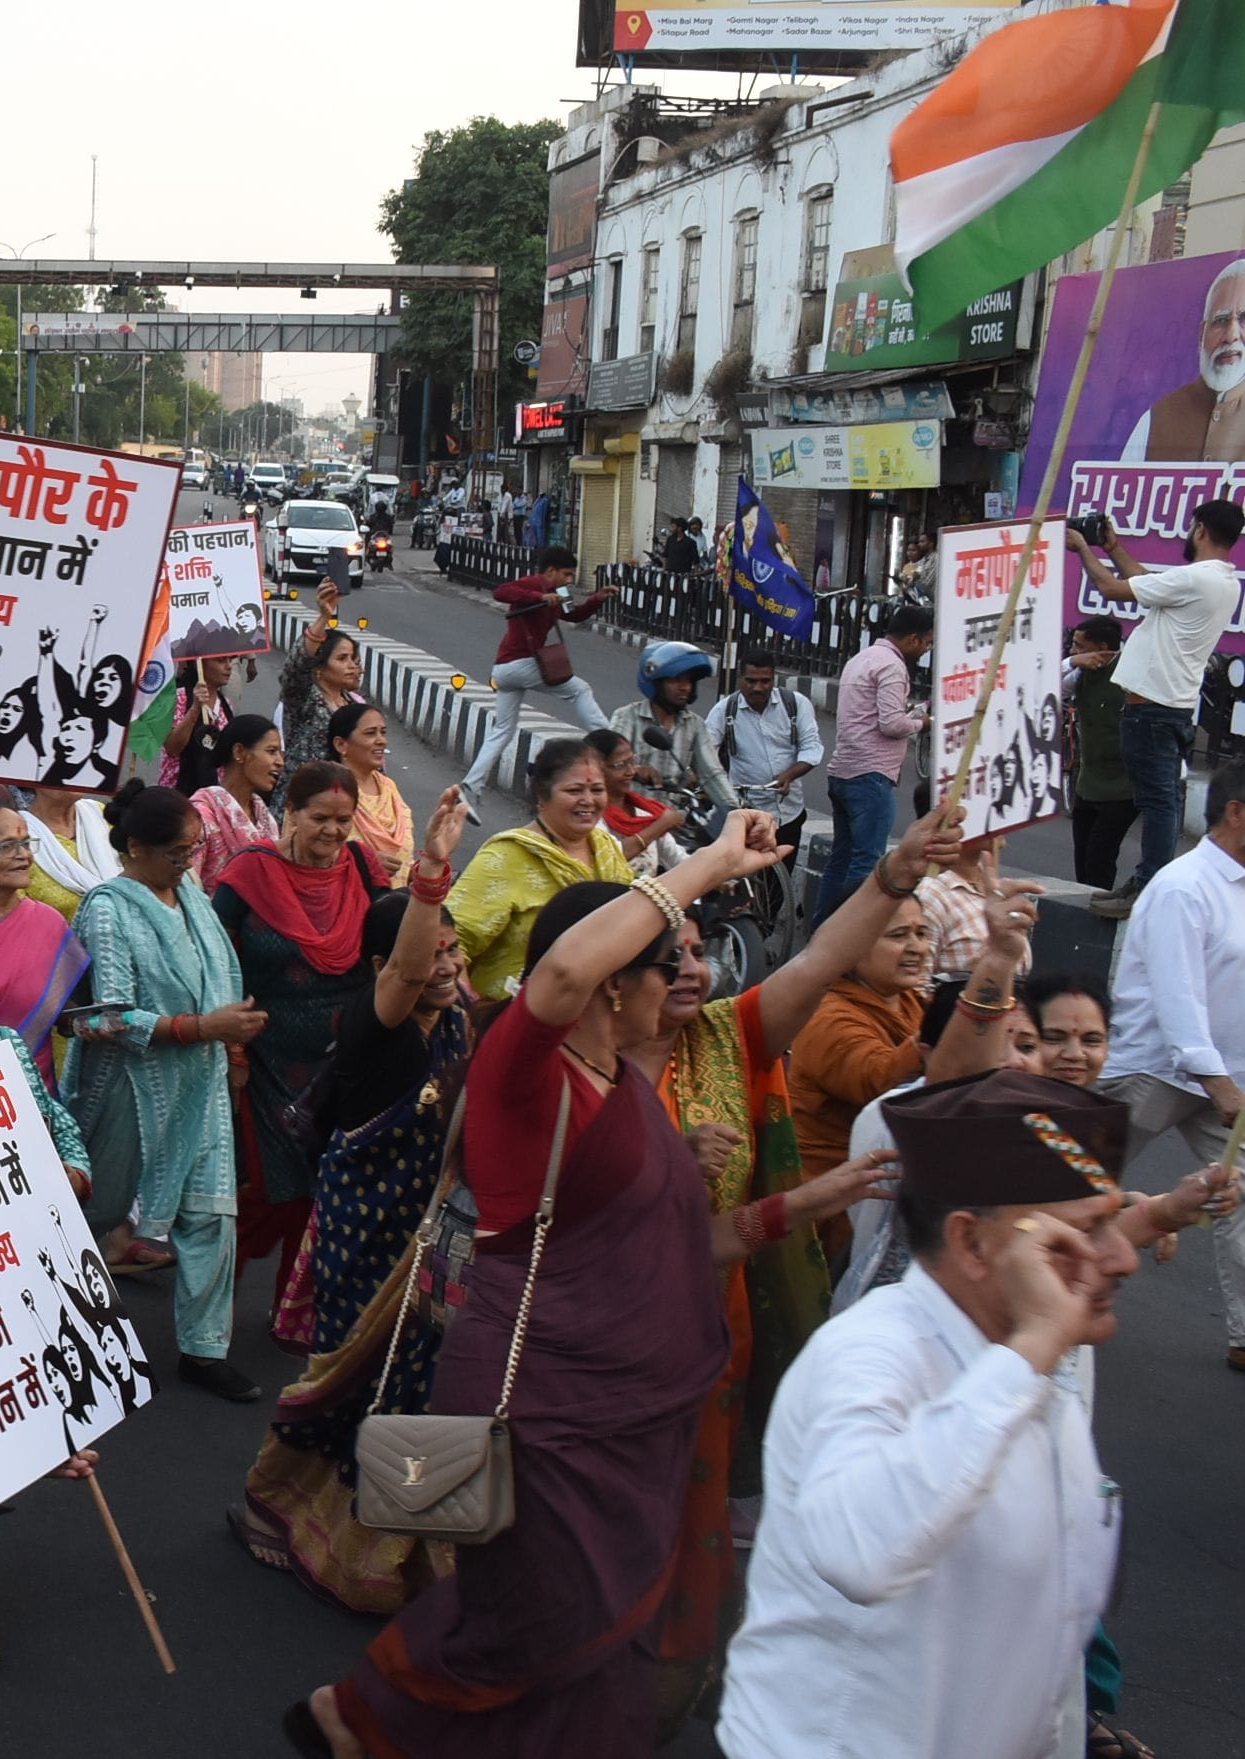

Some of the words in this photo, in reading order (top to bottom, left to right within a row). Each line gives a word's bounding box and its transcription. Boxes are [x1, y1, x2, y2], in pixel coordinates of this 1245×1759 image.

[661, 17, 677, 25] Mira
[693, 17, 713, 26] Marg
[729, 16, 753, 24] Gomti
[755, 17, 778, 25] Nagar
[786, 16, 818, 25] Telibagh
[842, 16, 863, 24] Vikas
[864, 17, 888, 25] Nagar
[920, 16, 944, 24] Nagar
[661, 29, 687, 37] Sitapur
[689, 28, 709, 36] Road
[729, 28, 773, 36] Mahanagar
[966, 290, 1012, 317] KRISHNA
[970, 321, 1004, 345] STORE
[826, 461, 841, 470] STORE
[84, 459, 138, 532] के
[168, 530, 189, 553] की
[192, 528, 255, 550] पहचान,
[57, 534, 99, 587] में
[174, 556, 212, 581] शक्ति
[171, 591, 210, 609] पमान
[2, 1140, 33, 1197] में
[20, 1355, 49, 1408] में
